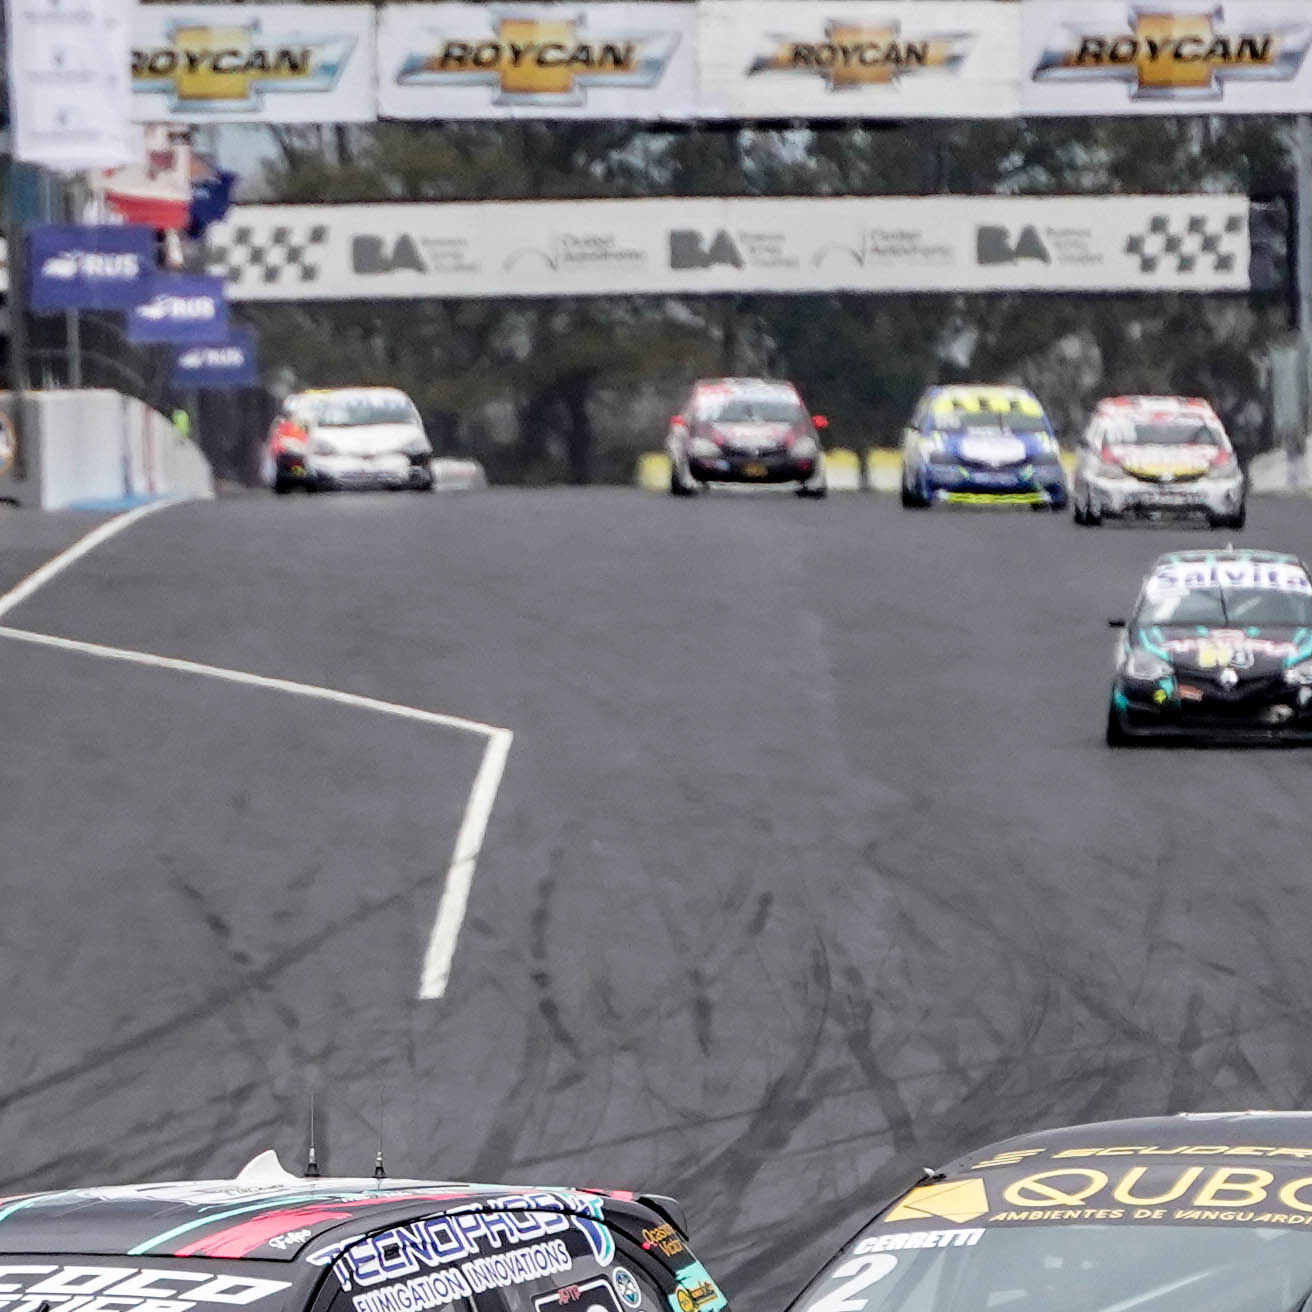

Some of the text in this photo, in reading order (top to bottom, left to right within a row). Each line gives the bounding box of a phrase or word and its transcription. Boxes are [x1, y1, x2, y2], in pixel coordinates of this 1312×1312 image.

[441, 40, 636, 70] ROYCAN
[791, 40, 930, 68] ROYCAN
[1074, 35, 1276, 65] ROYCAN
[82, 252, 139, 279] RUS
[989, 1208, 1120, 1223] AMBIENTES
[1135, 1208, 1167, 1221] DE
[305, 1192, 574, 1292] TECNOPHOS
[853, 1228, 987, 1255] CERRETTI
[463, 1238, 573, 1293] INNOVATIONS
